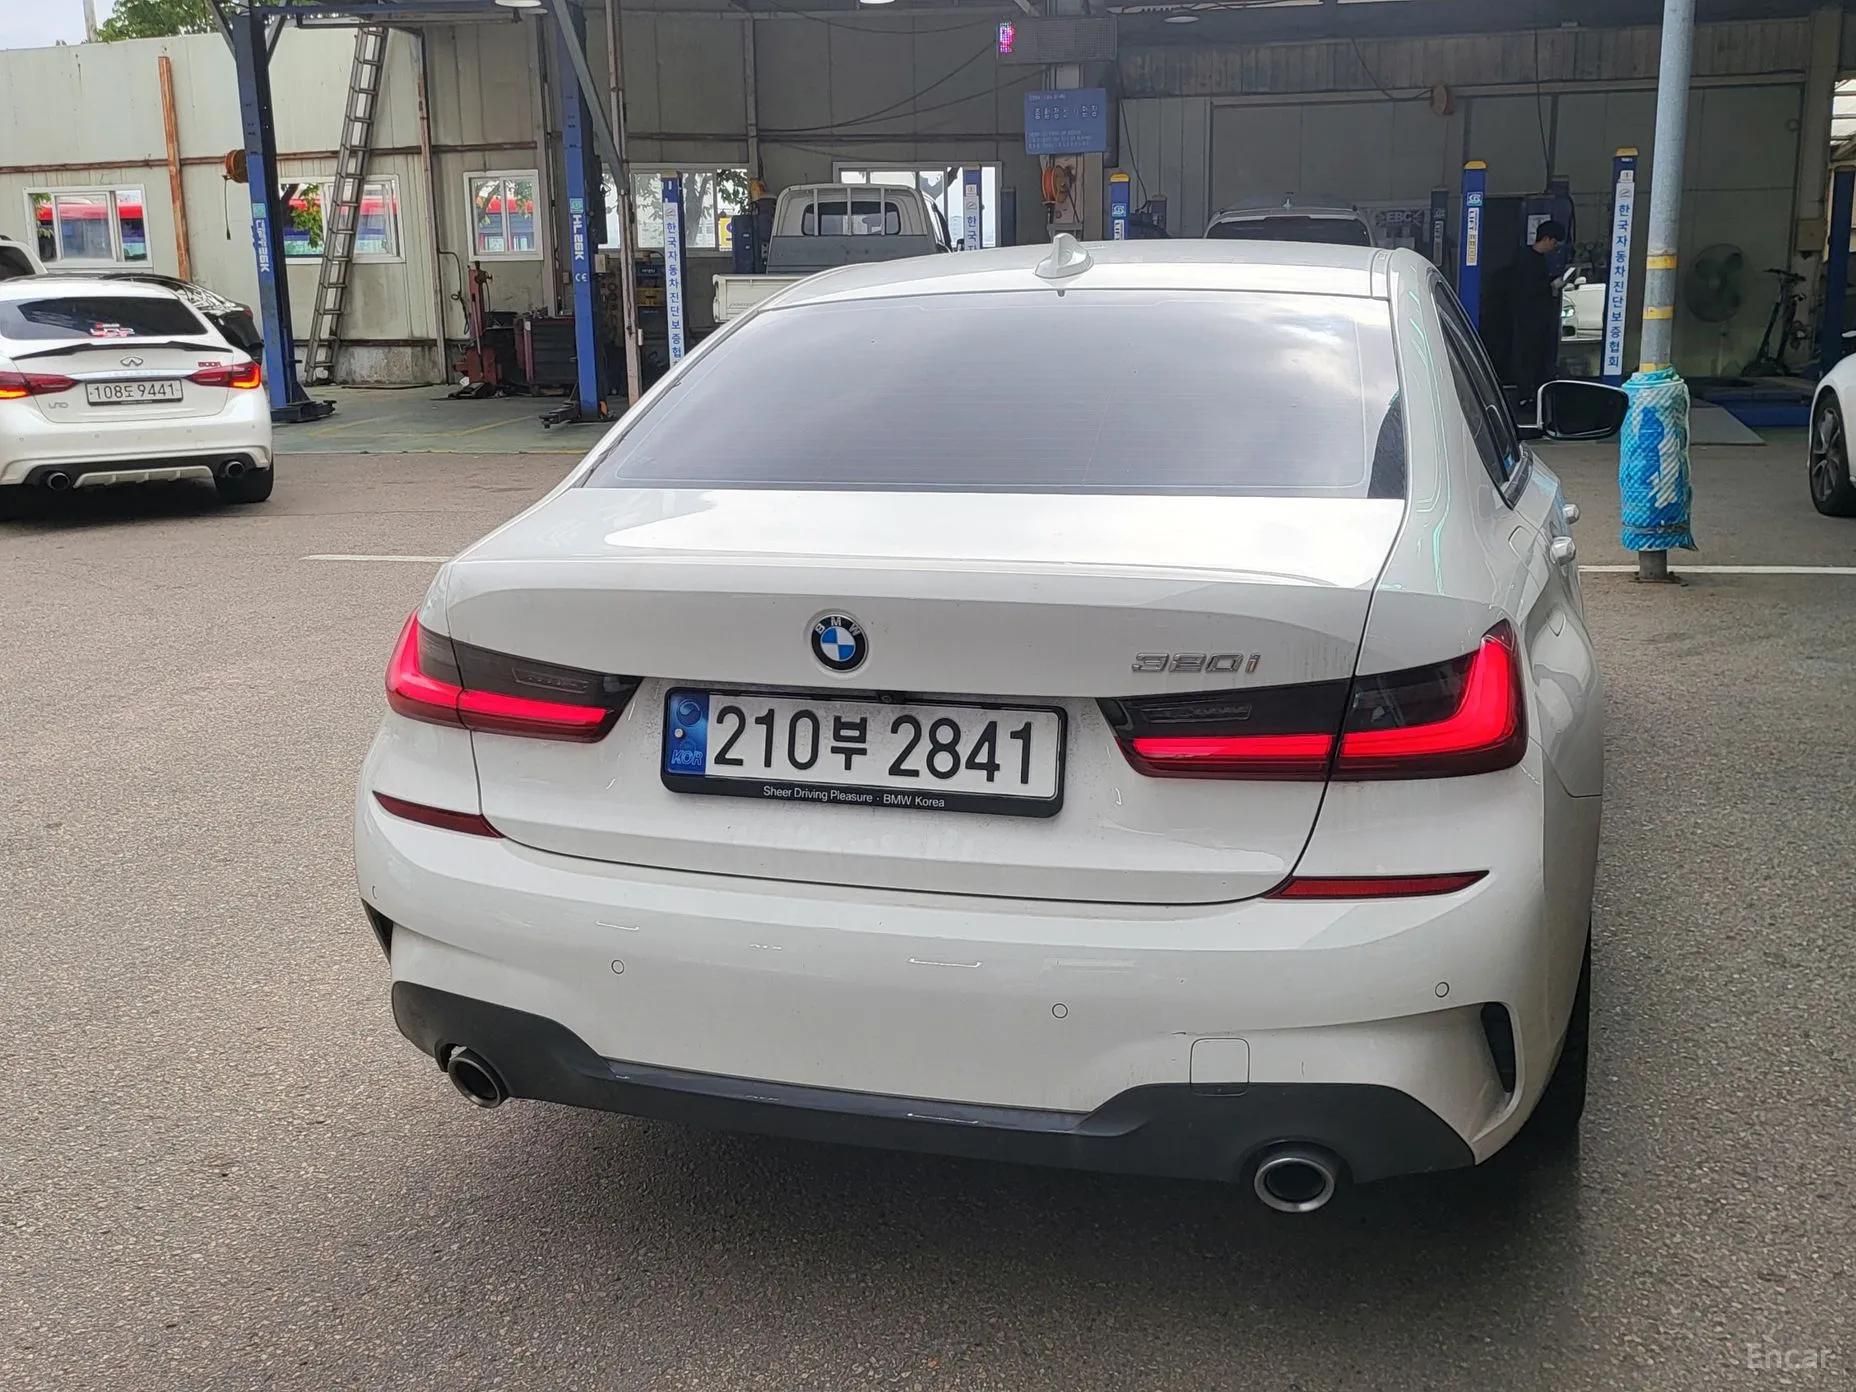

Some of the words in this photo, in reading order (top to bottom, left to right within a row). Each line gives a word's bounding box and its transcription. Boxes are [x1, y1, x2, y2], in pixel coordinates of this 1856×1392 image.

[666, 222, 682, 366] 한국자동차진단보증협
[1607, 203, 1631, 368] 한국자동차진단보증협회
[93, 384, 134, 400] 108도
[138, 383, 176, 398] 9441
[815, 616, 861, 637] BMW
[1131, 651, 1262, 674] 320i
[713, 703, 870, 772] 210부
[888, 713, 1034, 786] 2841
[671, 749, 704, 766] KOR
[763, 785, 792, 798] Sheer
[794, 787, 829, 802] Driving
[830, 788, 874, 803] Pleasure
[883, 793, 913, 805] BMW
[914, 796, 945, 808] Korea
